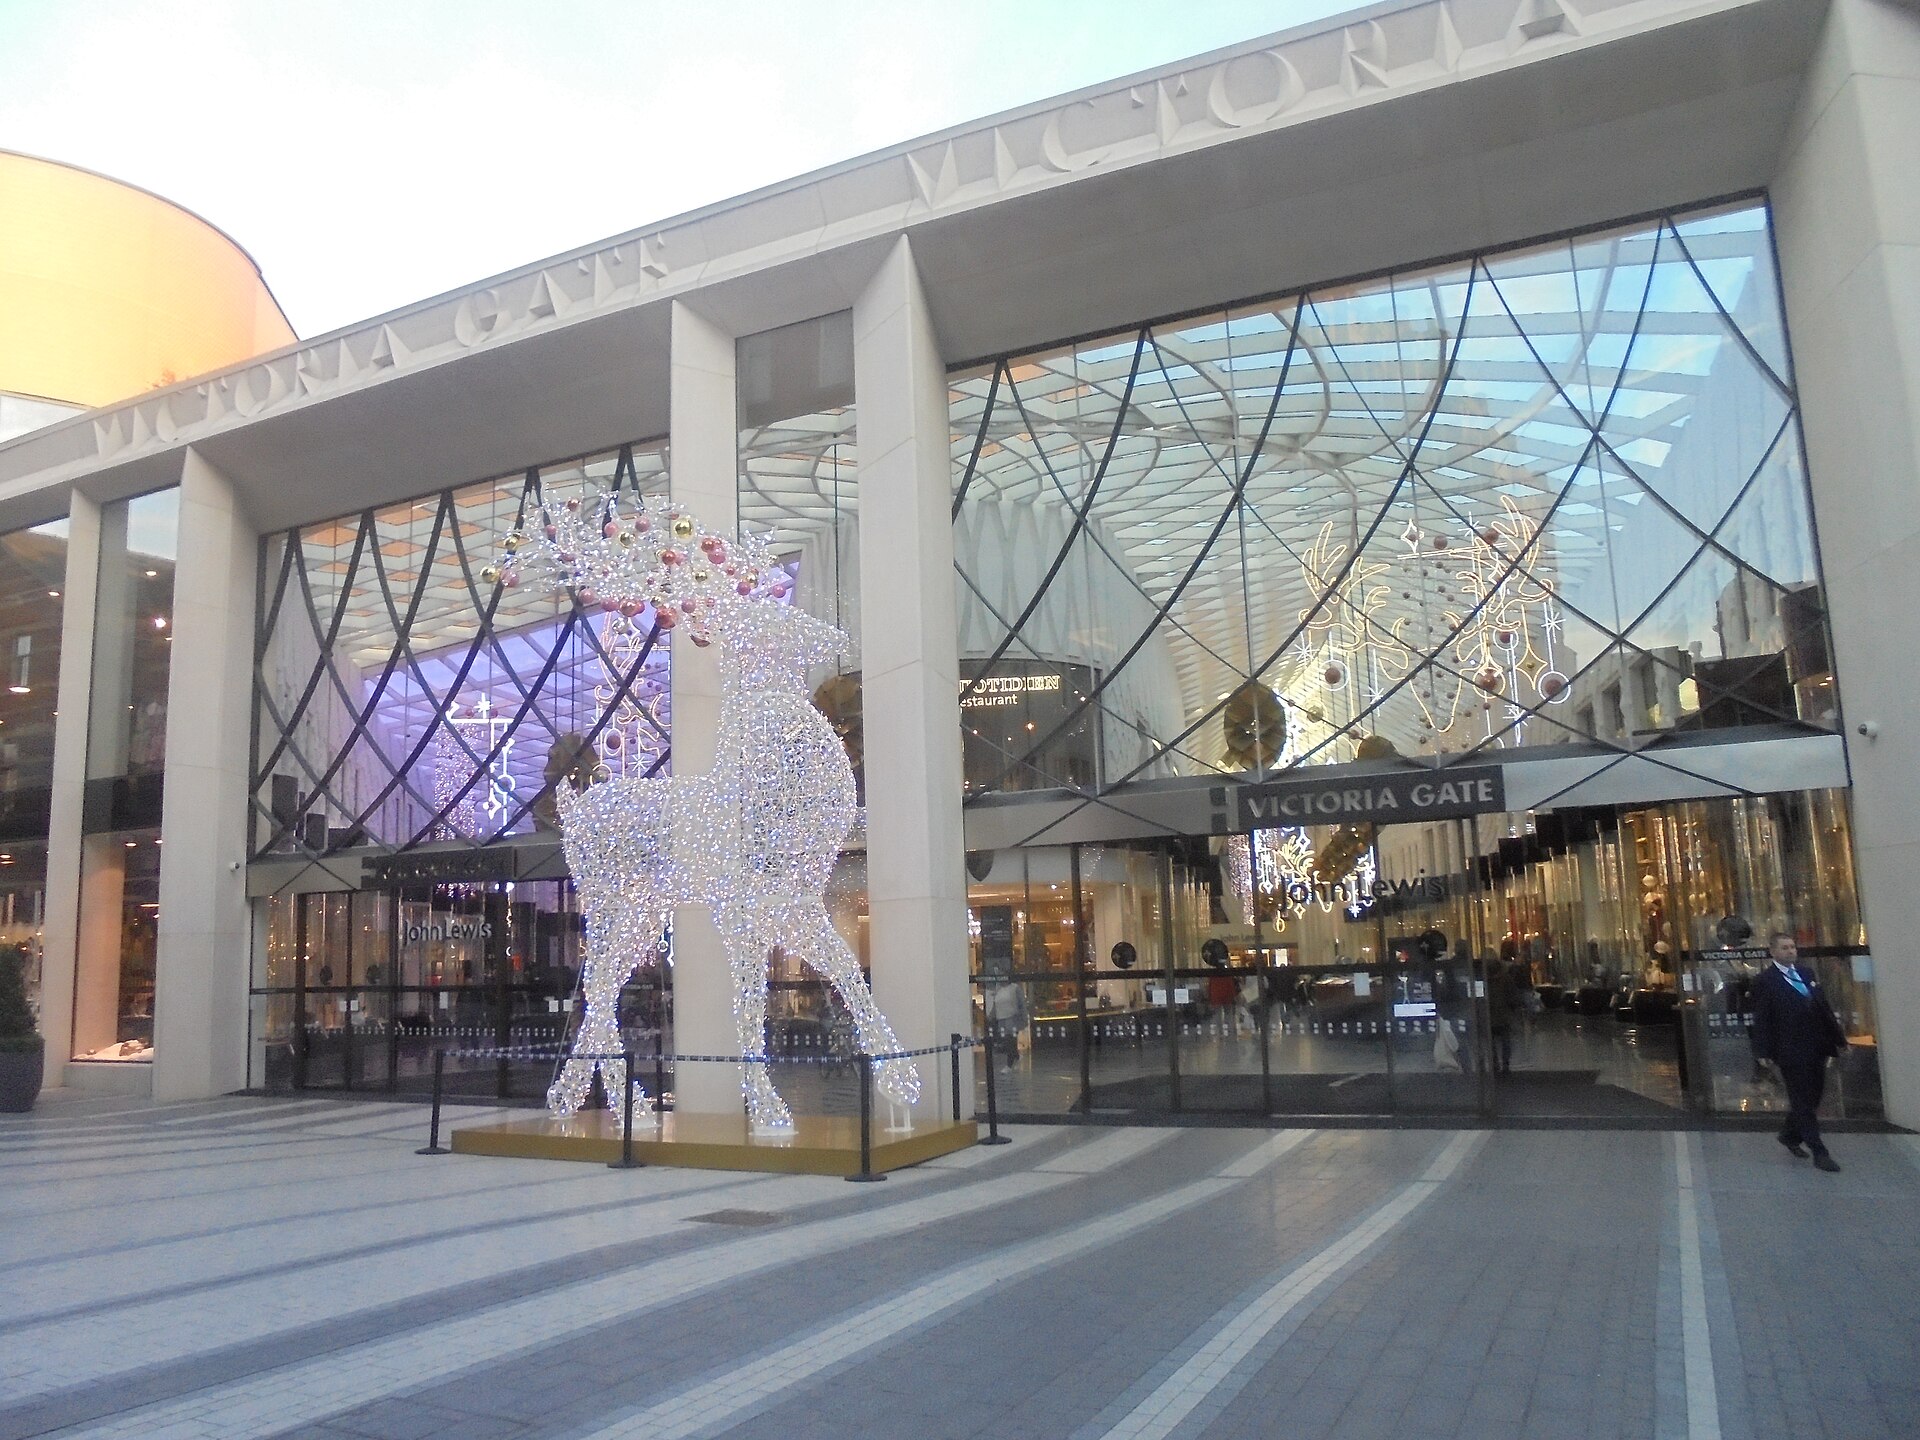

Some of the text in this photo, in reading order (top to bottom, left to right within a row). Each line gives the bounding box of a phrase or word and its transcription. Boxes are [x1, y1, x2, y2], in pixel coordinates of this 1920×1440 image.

[907, 0, 1583, 209] VICTORIA
[93, 231, 669, 459] VICTORIA GATE
[1247, 778, 1494, 819] VICTORIA GATE
[403, 915, 492, 946] John Lewis
[1702, 950, 1767, 960] VICTORIA GATE
